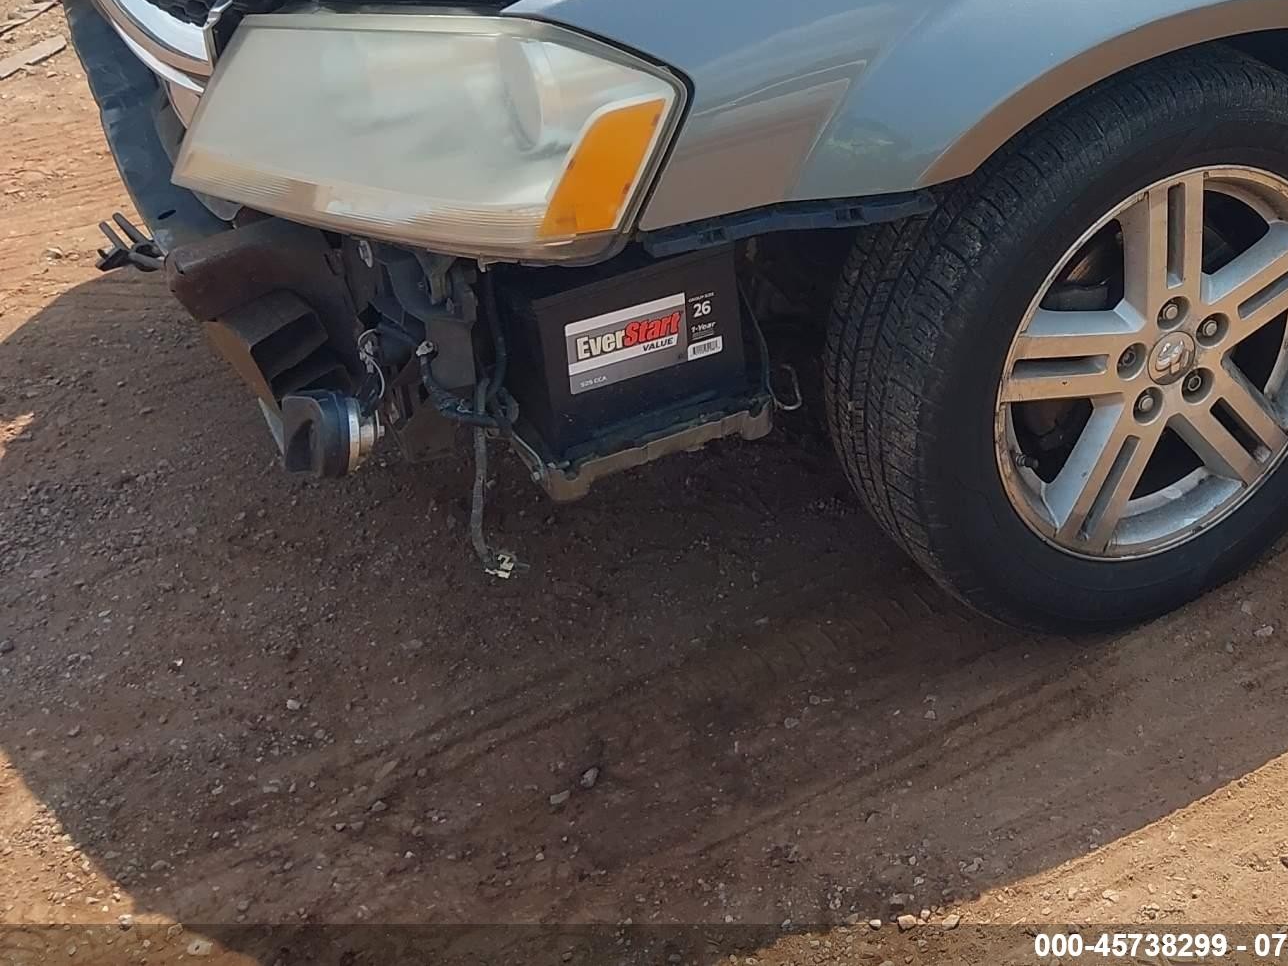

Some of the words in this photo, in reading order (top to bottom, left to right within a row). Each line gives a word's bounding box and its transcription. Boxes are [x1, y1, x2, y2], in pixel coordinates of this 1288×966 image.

[693, 300, 712, 318] 26
[690, 321, 717, 333] 1-Year
[575, 311, 682, 360] EverStart
[642, 337, 675, 352] VALUE
